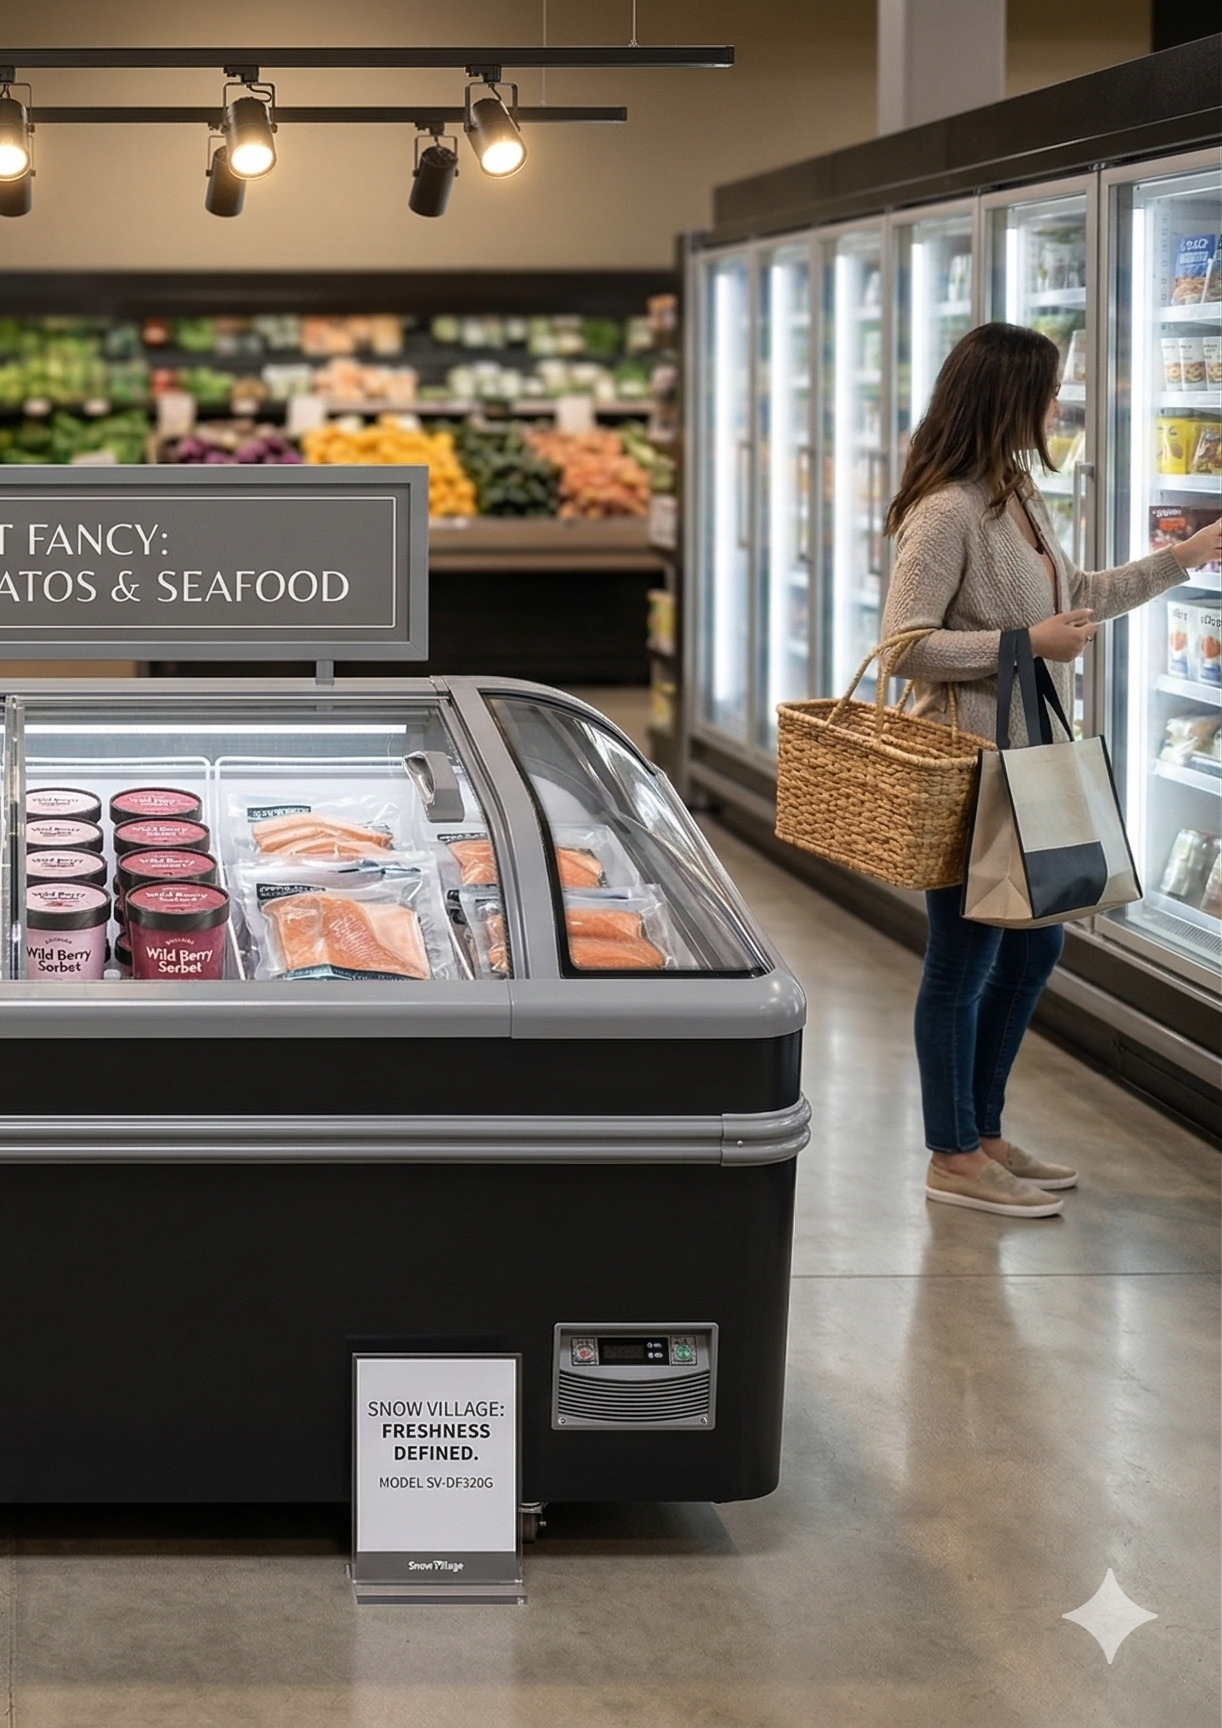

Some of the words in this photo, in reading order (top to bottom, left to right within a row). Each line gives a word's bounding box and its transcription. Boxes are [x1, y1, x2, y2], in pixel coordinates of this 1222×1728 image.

[29, 523, 169, 556] FANCY:
[111, 570, 141, 603] &
[157, 570, 350, 603] SEAFOOD
[26, 946, 54, 960] Wild
[57, 949, 91, 962] Berry
[146, 946, 176, 961] Wild
[179, 949, 213, 962] Berry
[38, 960, 81, 973] Sorbet
[367, 1400, 423, 1418] SNOW
[426, 1400, 505, 1418] VILLAGE:
[382, 1423, 491, 1439] FRESHNESS
[394, 1445, 480, 1461] DEFINED.
[379, 1476, 424, 1489] MODEL
[426, 1476, 494, 1489] SV-DF320G
